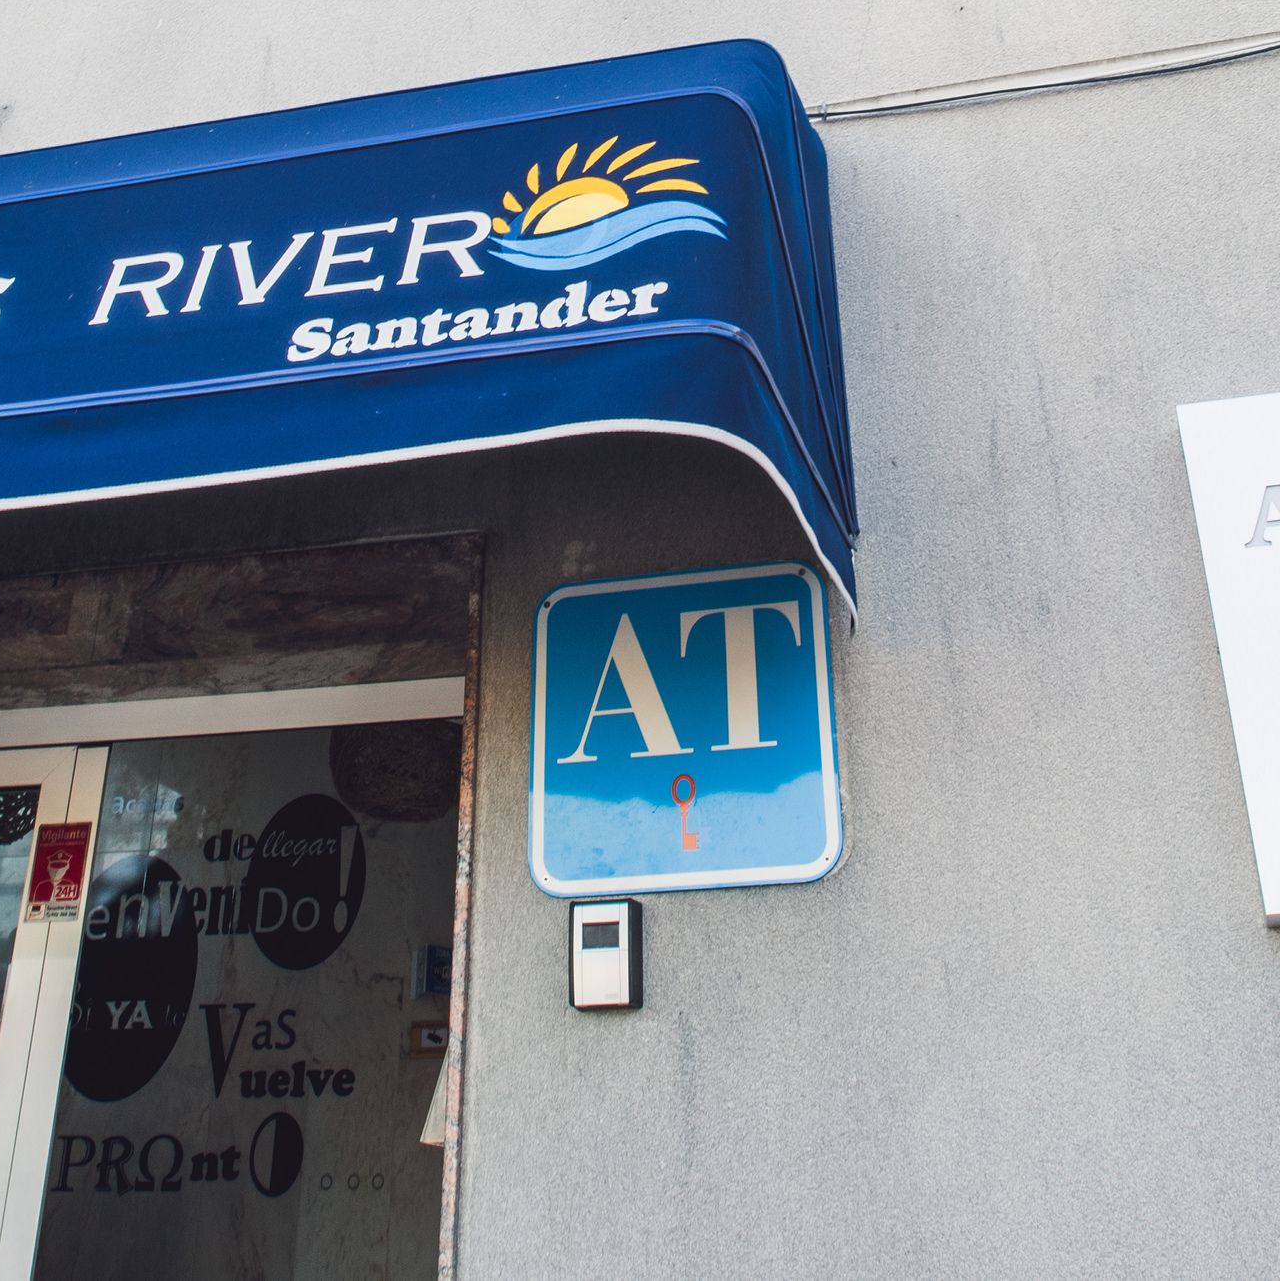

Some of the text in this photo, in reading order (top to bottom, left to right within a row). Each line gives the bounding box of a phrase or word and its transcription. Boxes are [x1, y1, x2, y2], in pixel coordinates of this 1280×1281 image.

[89, 210, 494, 326] RIVER
[287, 280, 669, 364] Santander
[556, 599, 802, 765] AT
[42, 829, 87, 842] Vigilante
[204, 829, 337, 867] de llegar
[55, 885, 76, 898] 24H
[105, 1000, 154, 1030] YA
